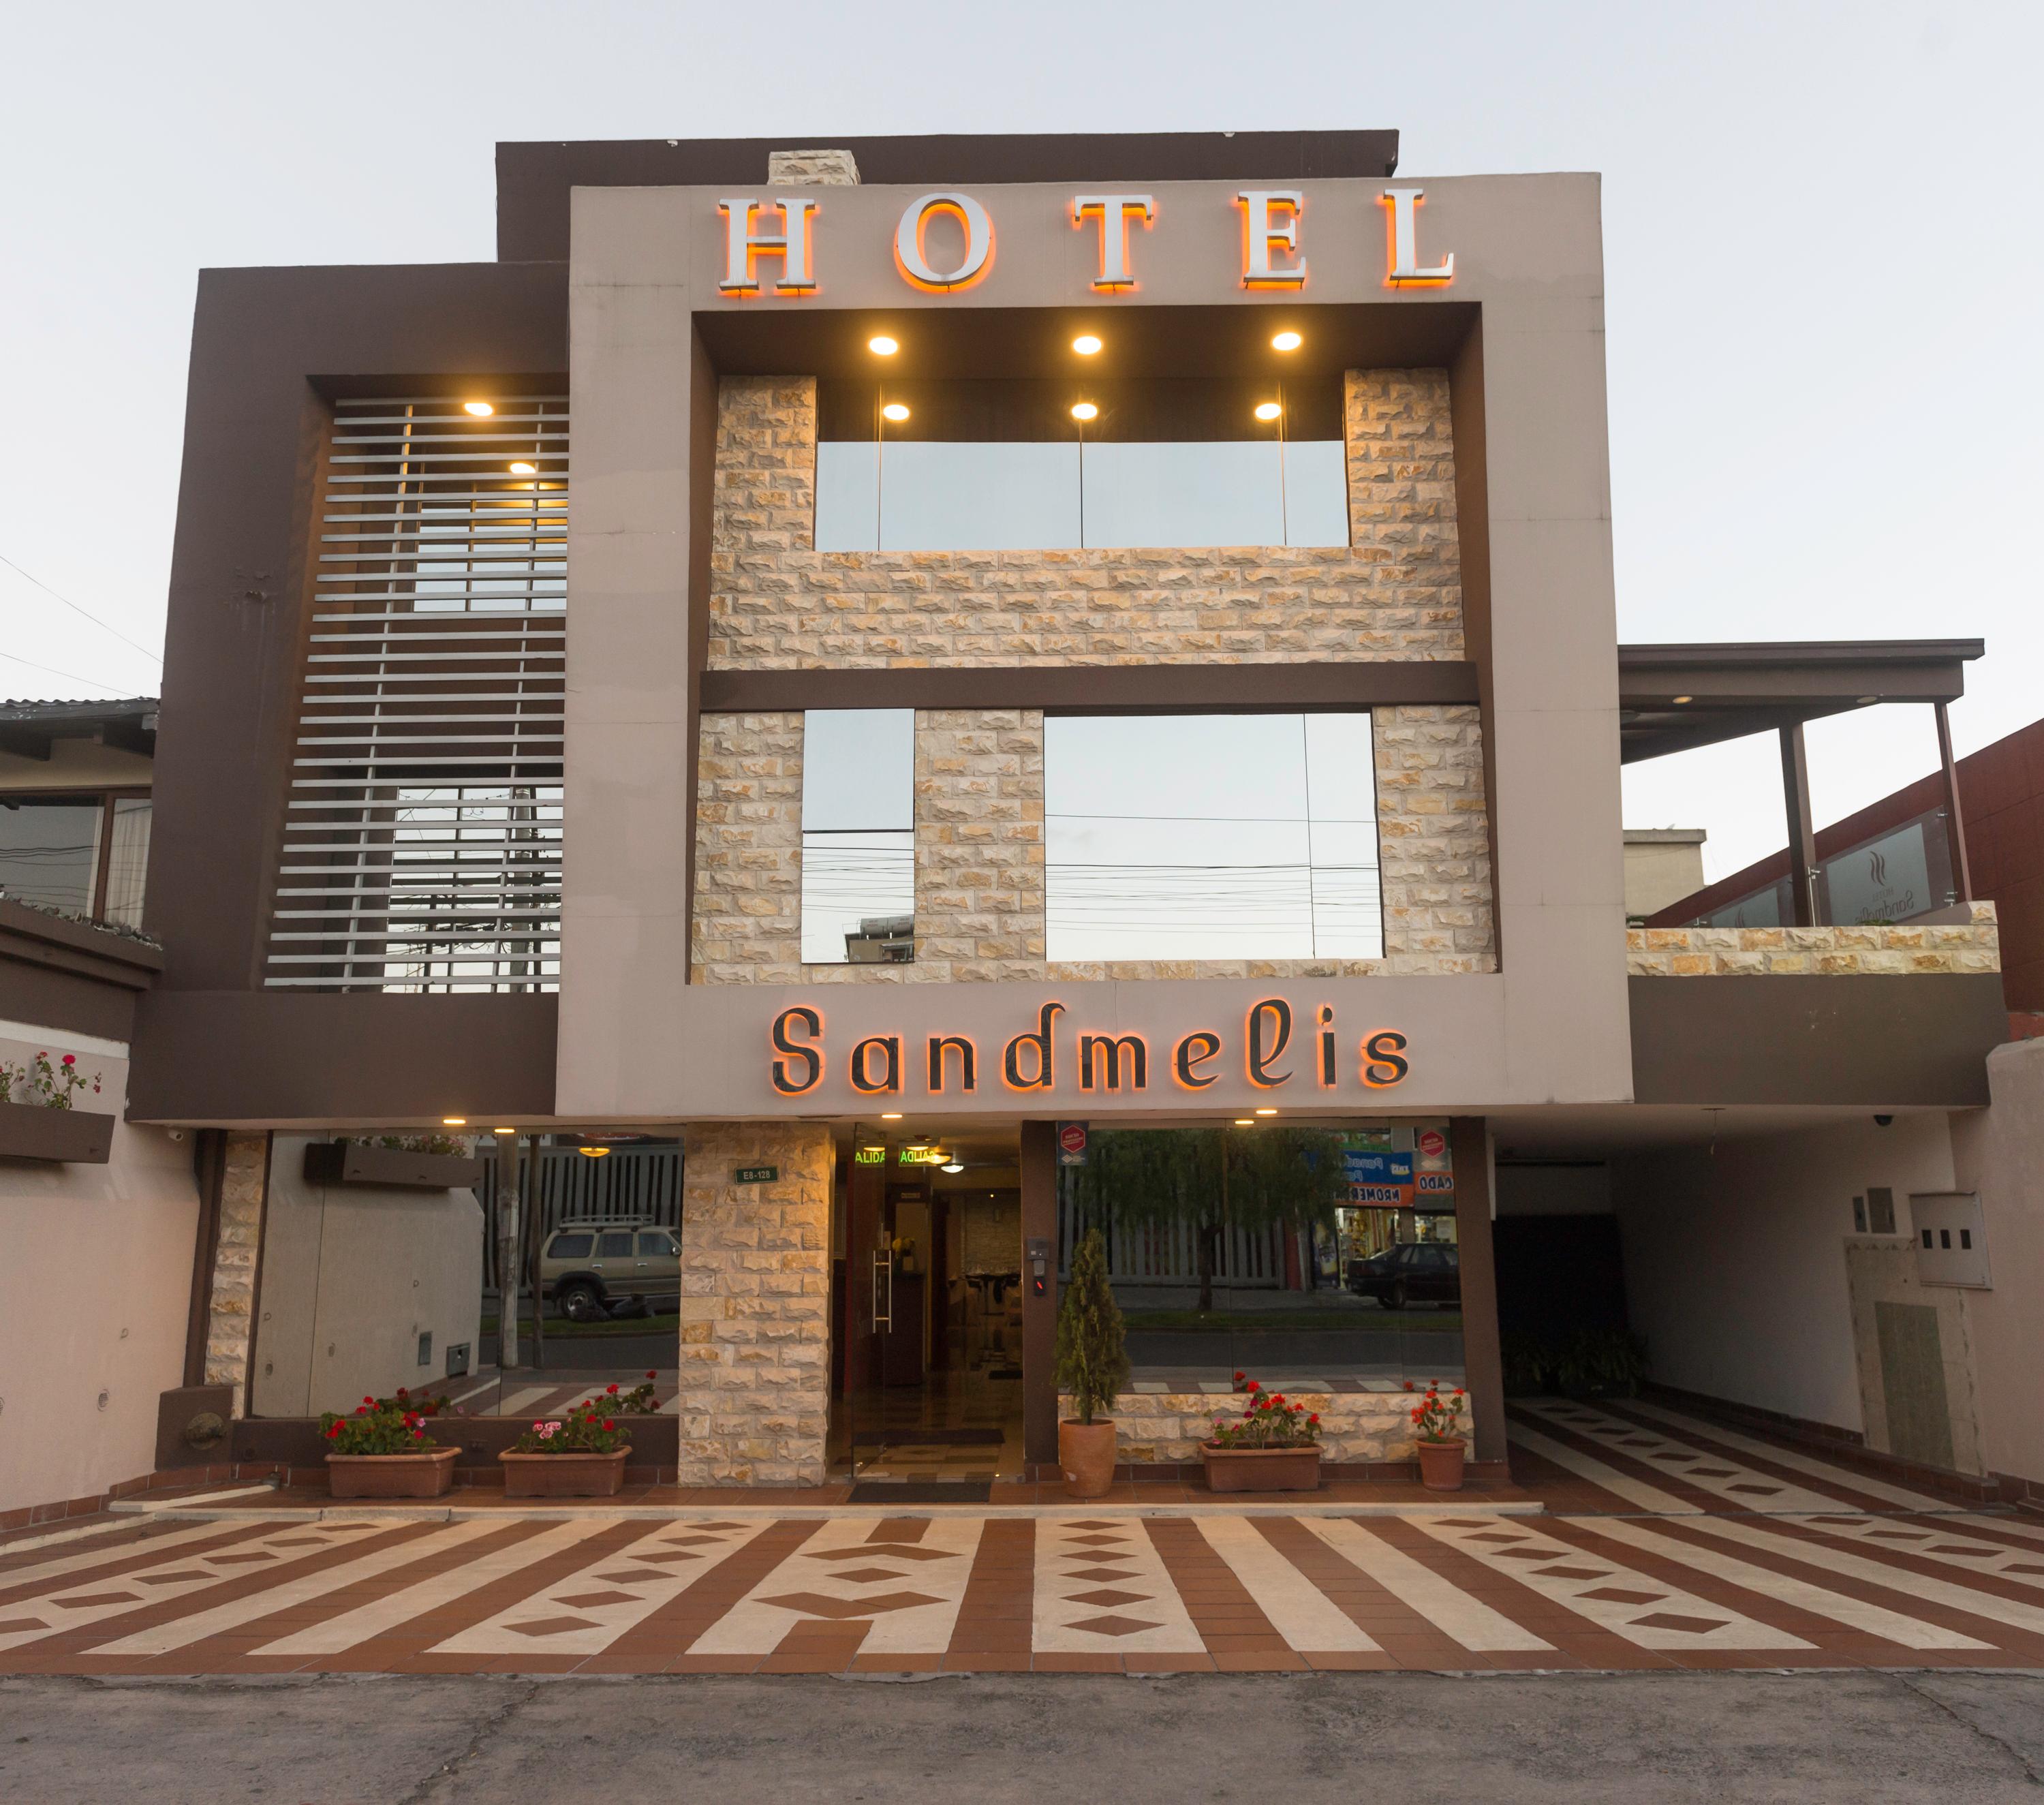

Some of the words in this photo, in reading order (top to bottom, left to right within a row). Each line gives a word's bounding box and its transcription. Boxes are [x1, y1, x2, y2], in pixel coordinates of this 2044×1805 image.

[718, 188, 1455, 291] HOTEL
[772, 998, 1409, 1093] Sandmelis
[743, 1171, 771, 1179] E8-128
[855, 1152, 885, 1163] ALIDA
